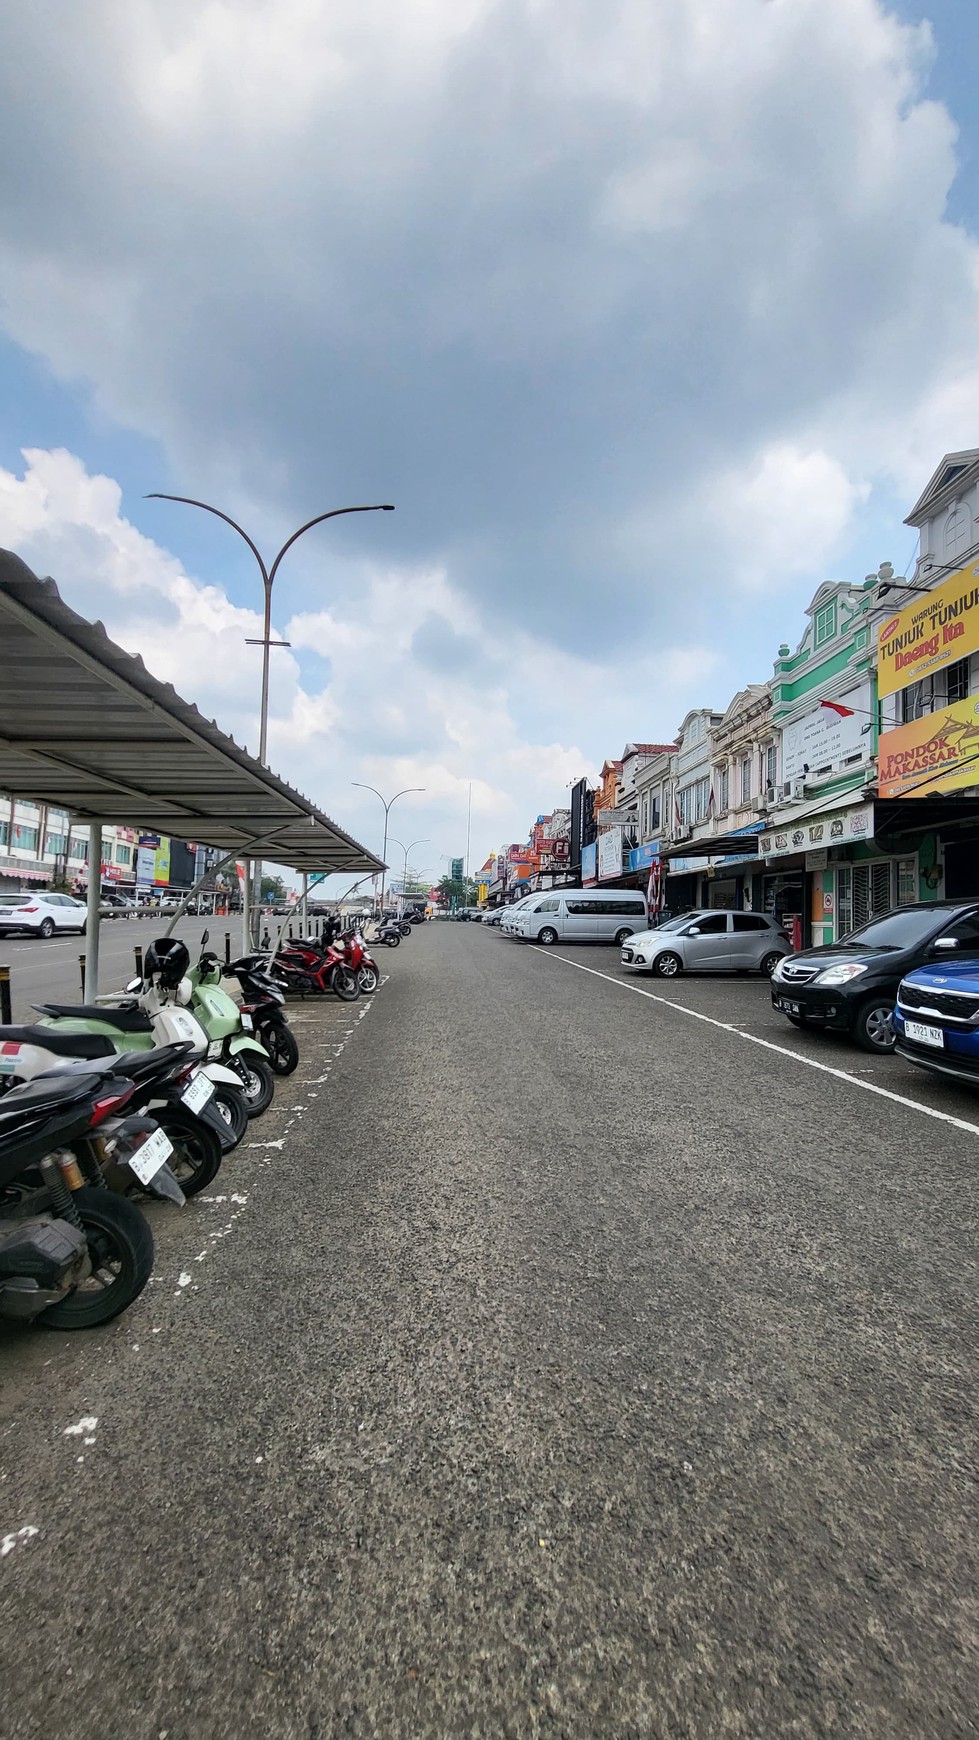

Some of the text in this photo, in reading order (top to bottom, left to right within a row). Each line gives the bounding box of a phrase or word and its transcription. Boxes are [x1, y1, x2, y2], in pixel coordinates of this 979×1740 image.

[911, 599, 943, 625] WARUNG
[880, 622, 924, 660] TUNJUK
[895, 621, 965, 672] Daeng Ita
[880, 747, 959, 782] MAKASSAR
[887, 735, 950, 768] PONDOK
[905, 1022, 909, 1032] B
[912, 1024, 928, 1036] 1921
[929, 1028, 942, 1040] NZK
